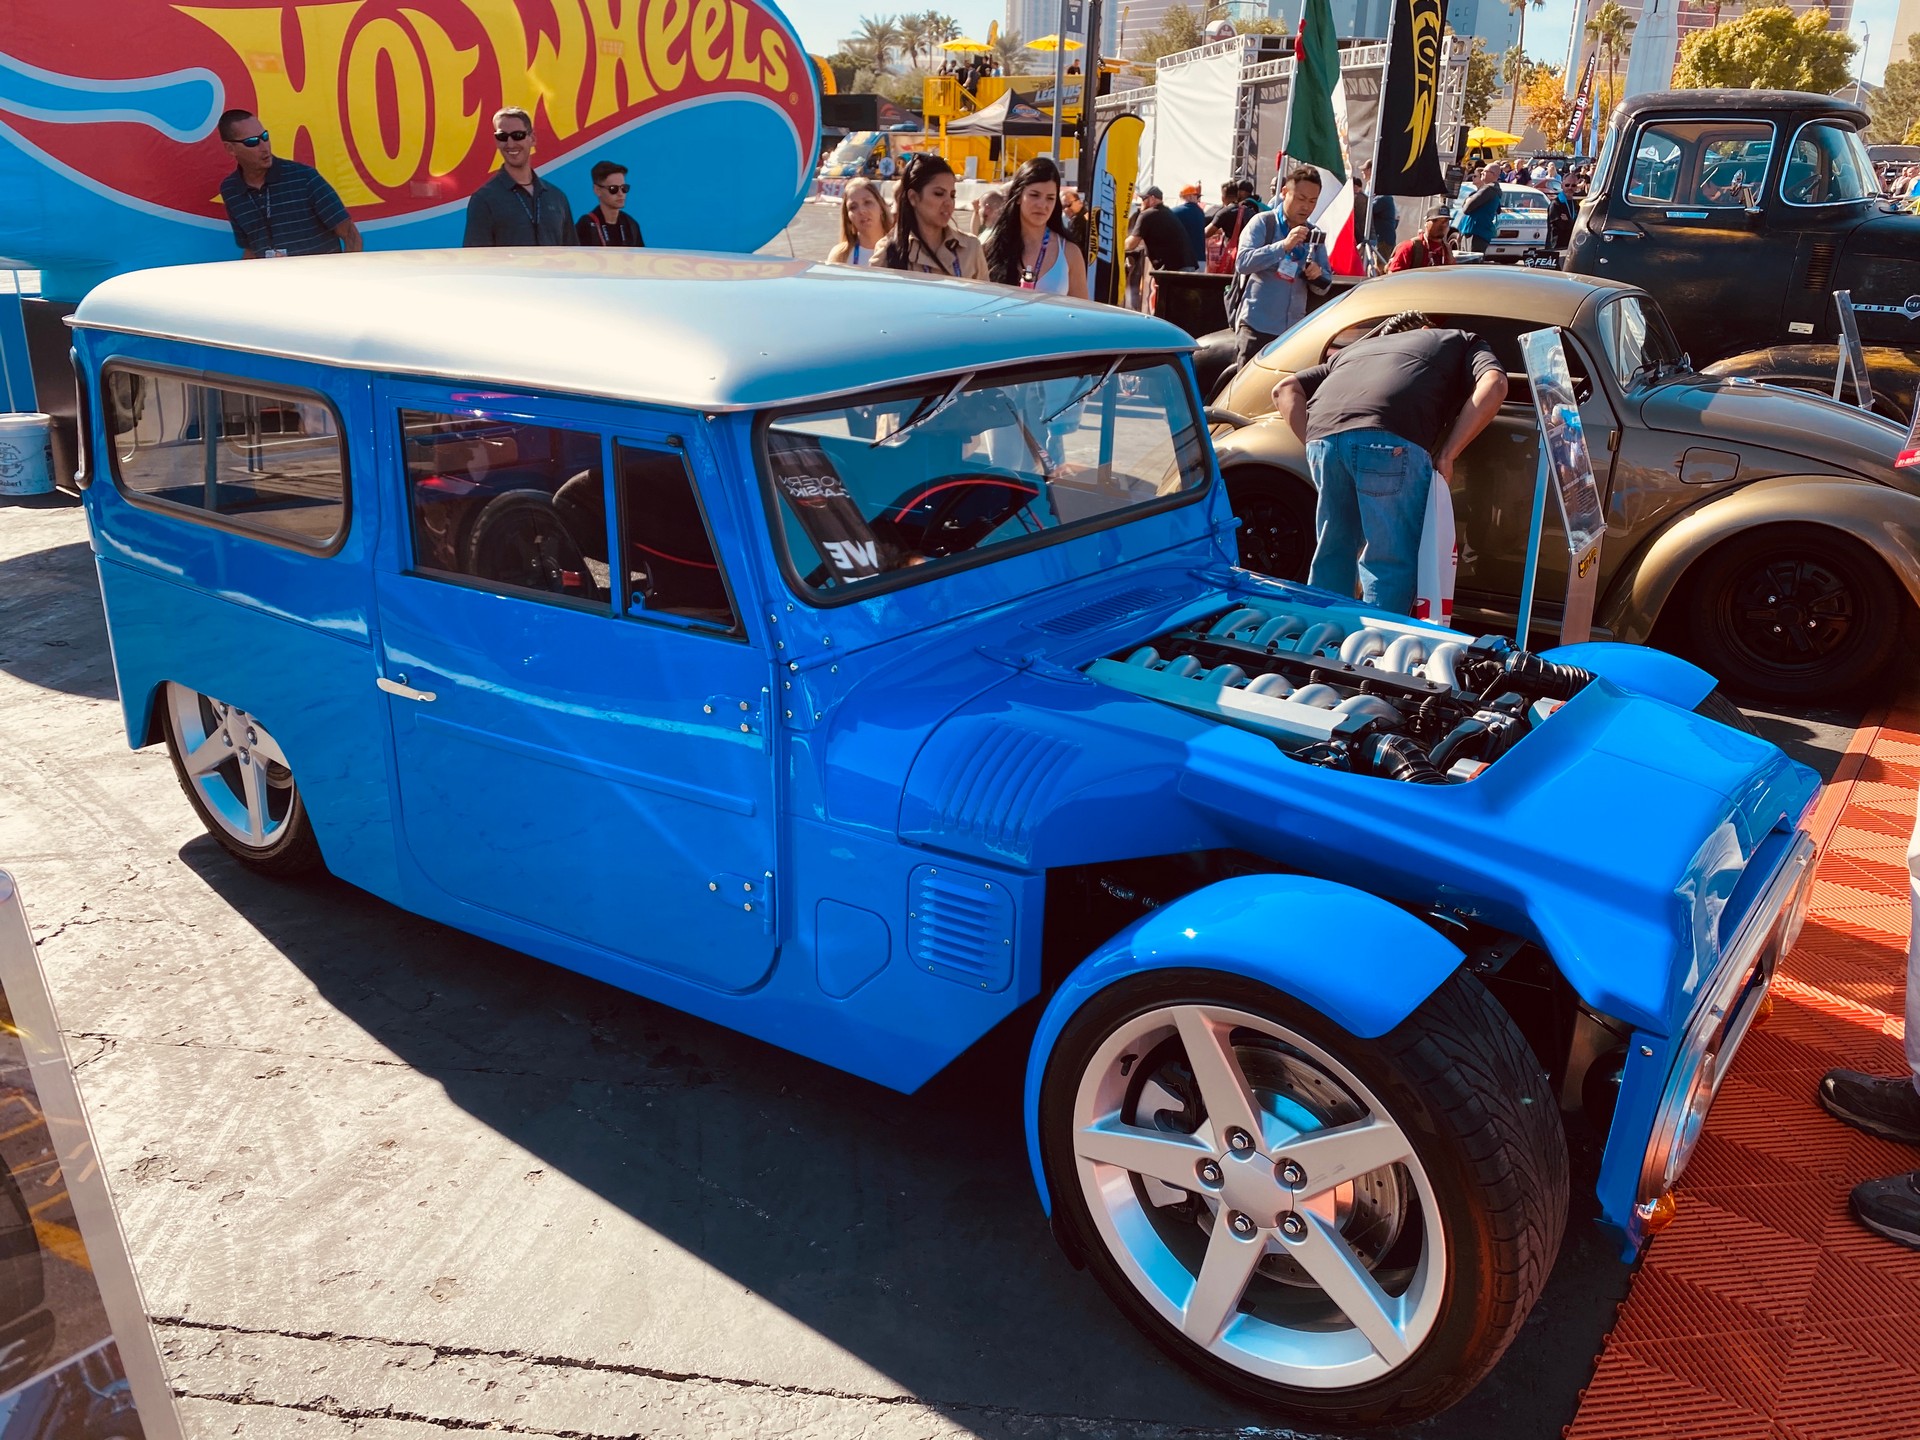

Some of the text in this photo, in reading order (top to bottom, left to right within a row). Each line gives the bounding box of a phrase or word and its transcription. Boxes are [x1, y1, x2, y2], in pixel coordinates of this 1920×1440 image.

[1035, 84, 1082, 103] LEGNDS
[1098, 169, 1116, 264] LEGENDS
[1535, 257, 1557, 266] FEAL
[1854, 304, 1897, 312] FORD
